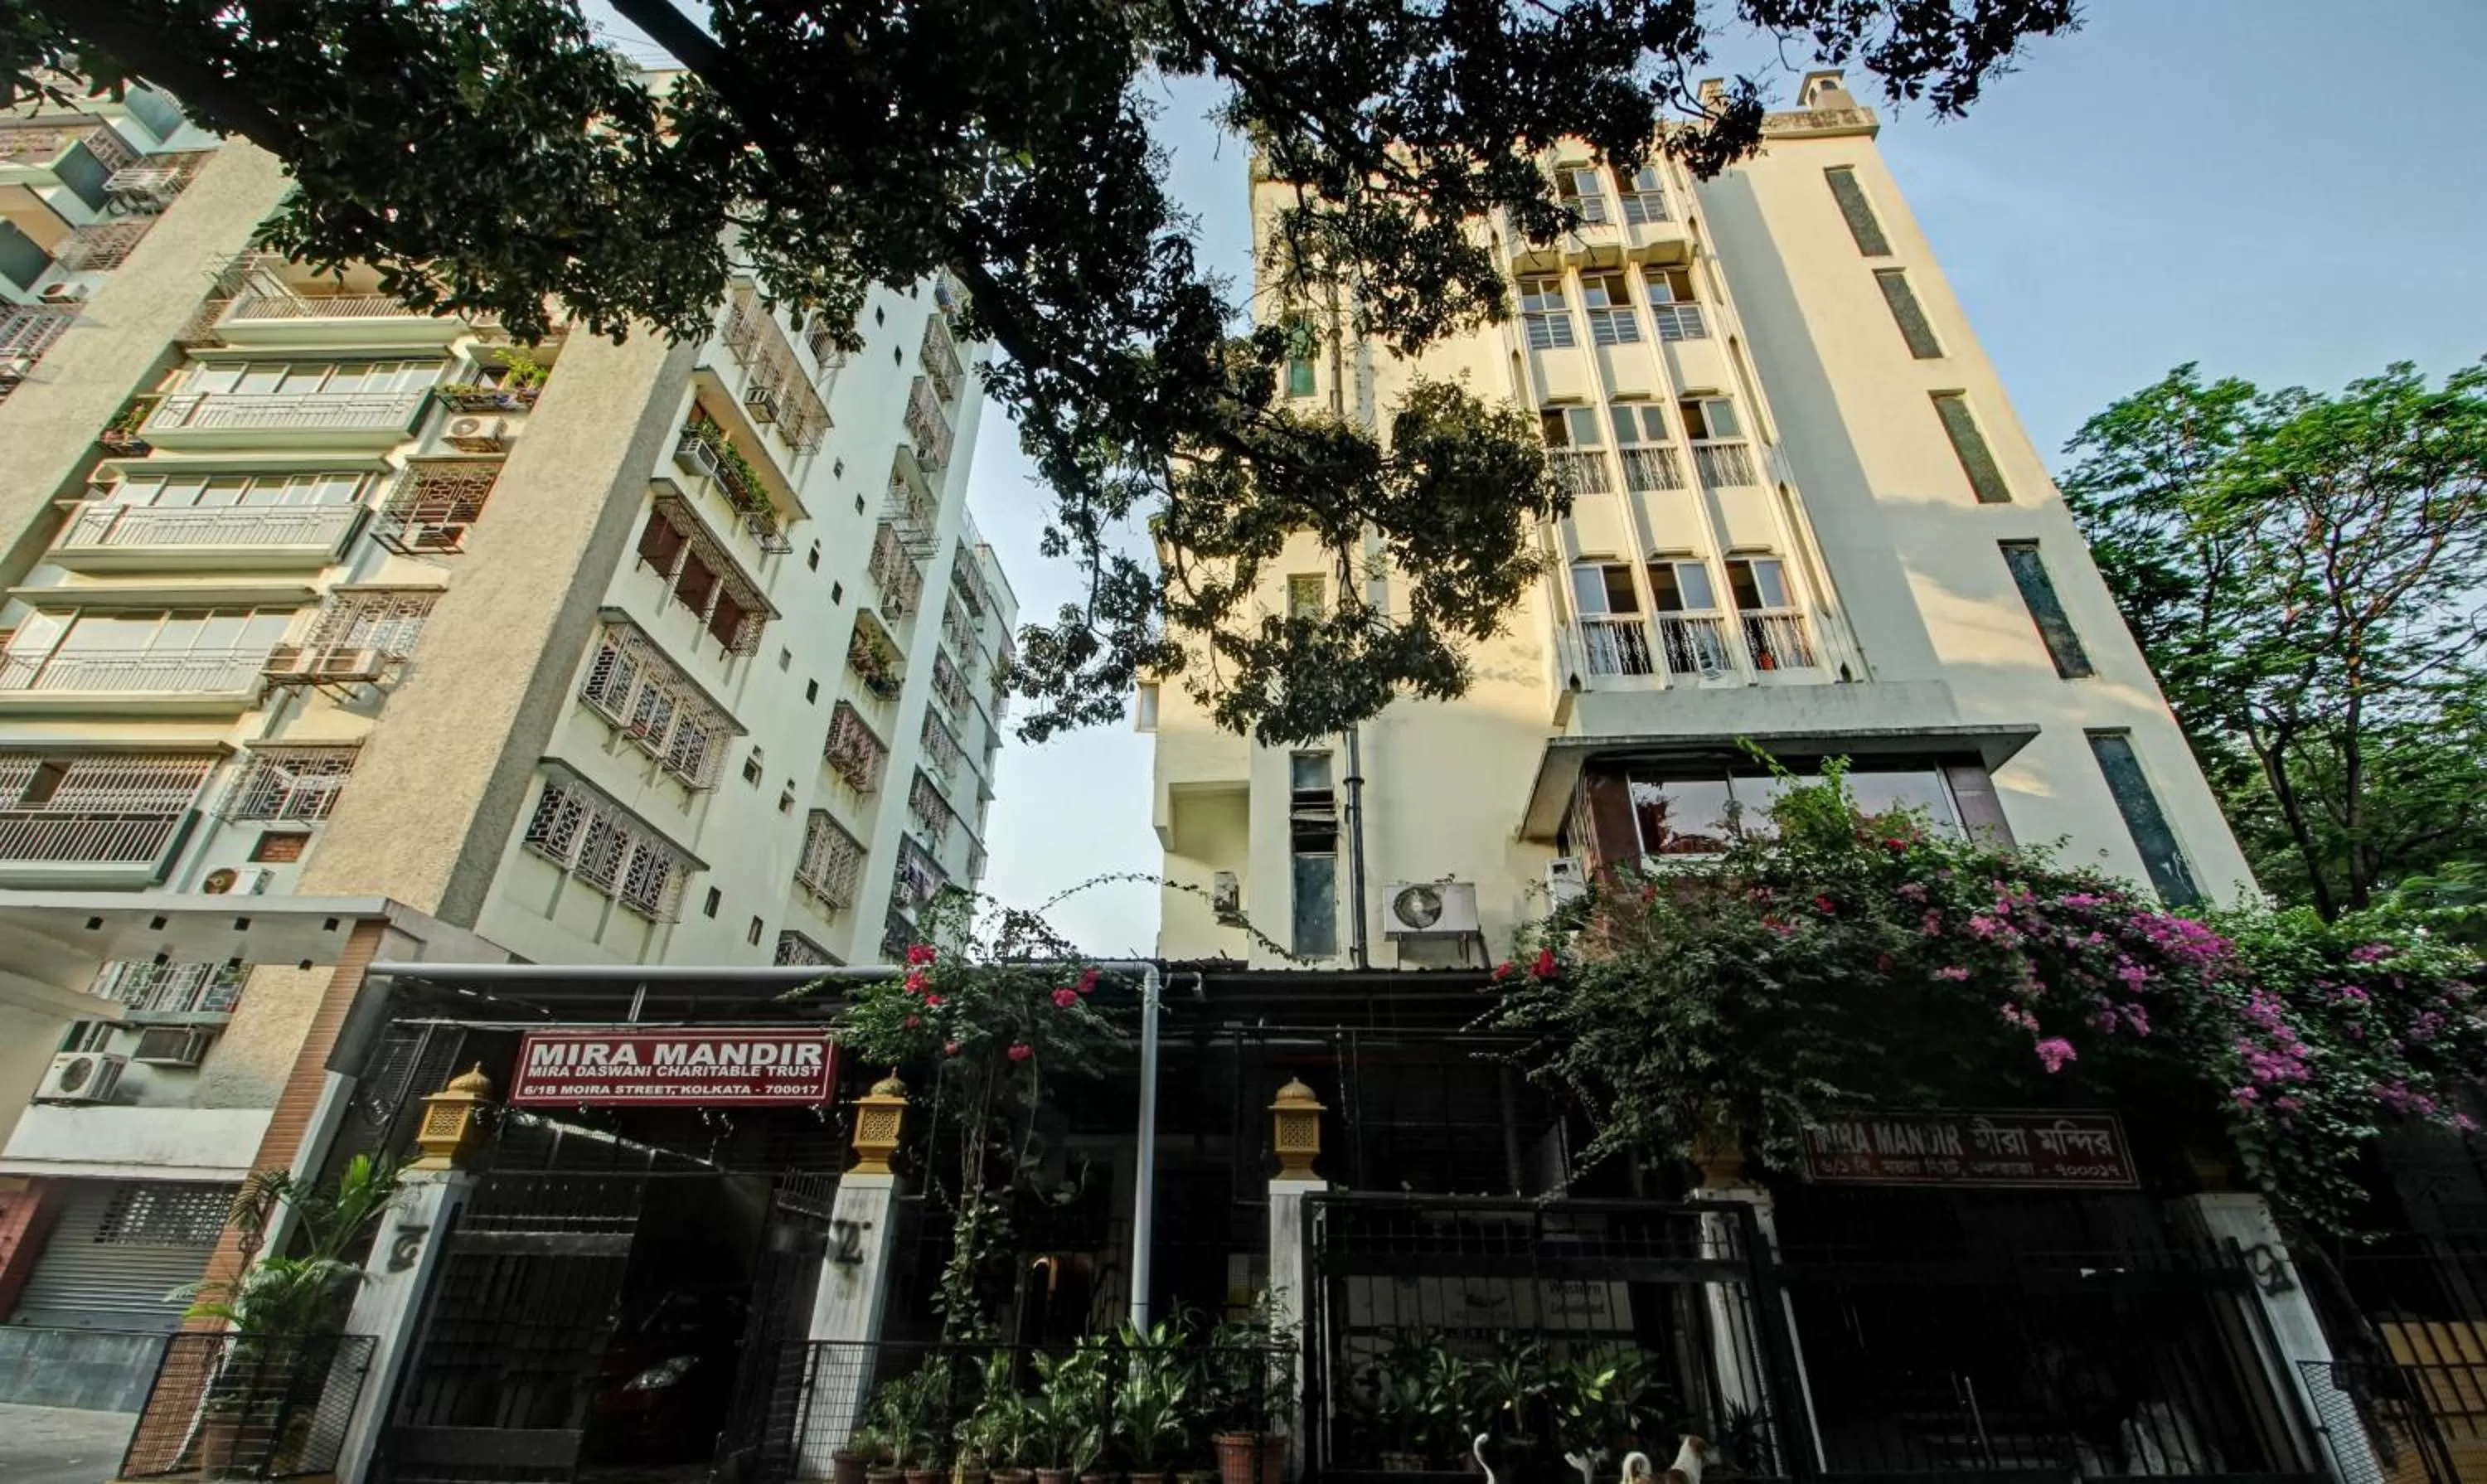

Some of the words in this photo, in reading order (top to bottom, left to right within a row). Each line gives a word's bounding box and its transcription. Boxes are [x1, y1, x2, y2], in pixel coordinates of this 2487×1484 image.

[531, 1043, 638, 1065] MIRA
[653, 1043, 822, 1065] MANDIR
[527, 1065, 570, 1077] MIRA
[575, 1065, 652, 1077] DASWANI
[656, 1065, 760, 1078] CHARITABLE
[767, 1066, 821, 1078] TRUST
[523, 1085, 555, 1095] 6/1B
[560, 1085, 611, 1095] MOIRA
[615, 1085, 676, 1096] STREET,
[681, 1086, 751, 1095] KOLKATA
[765, 1086, 819, 1095] 700017
